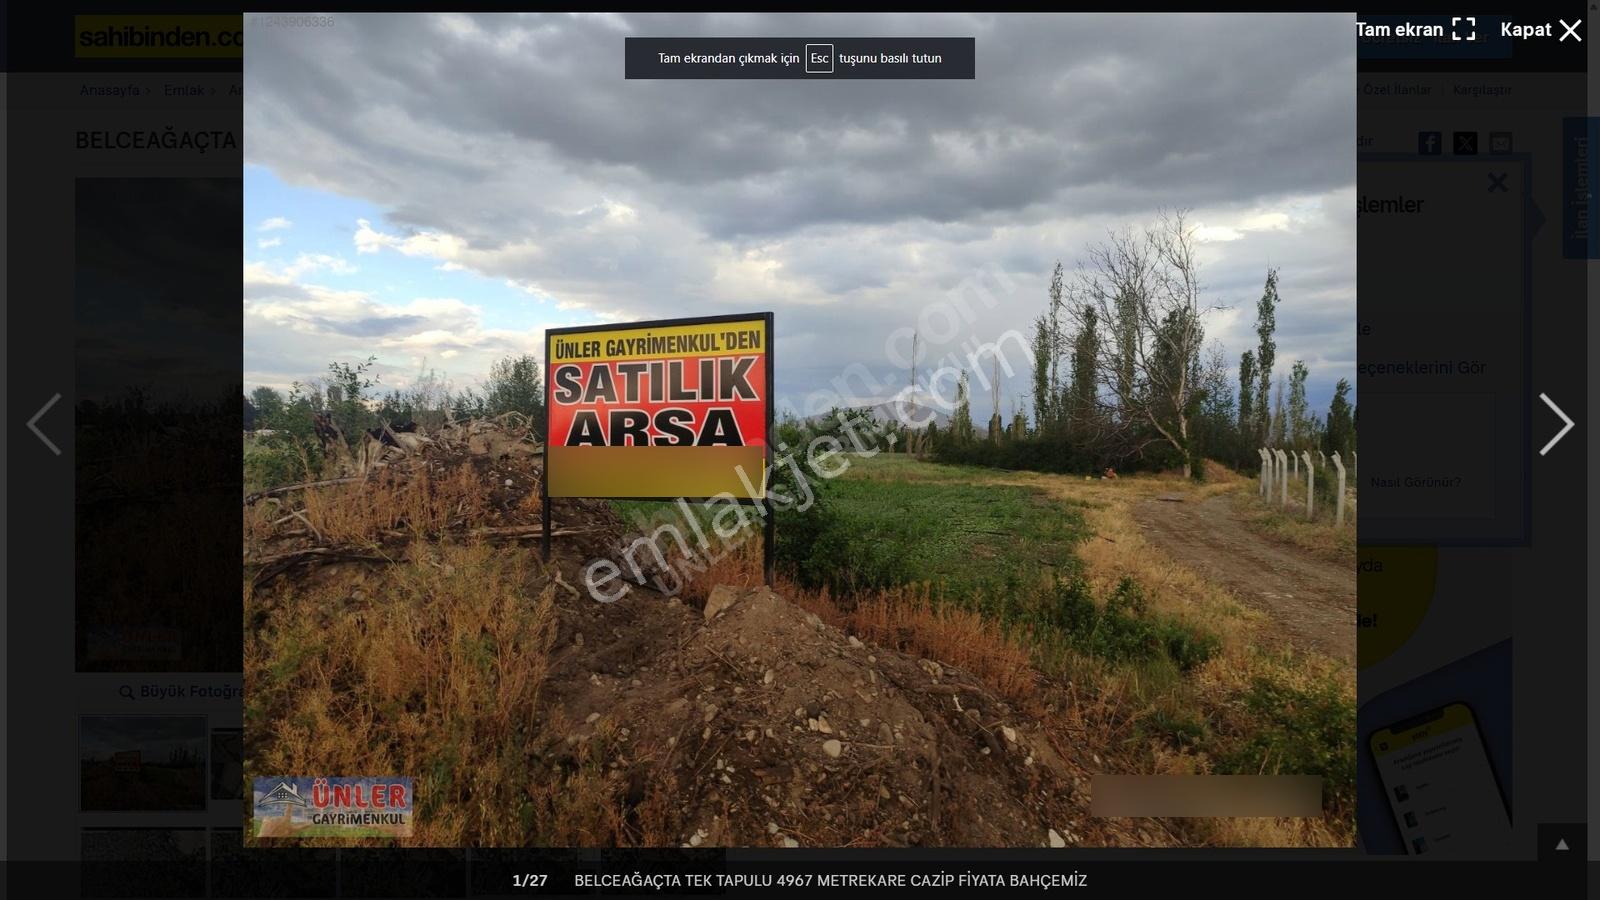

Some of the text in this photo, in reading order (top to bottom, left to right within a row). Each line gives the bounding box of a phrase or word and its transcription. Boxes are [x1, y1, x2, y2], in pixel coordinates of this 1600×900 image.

[1356, 22, 1444, 37] Tam ekran
[1501, 22, 1553, 40] Kapat
[658, 53, 942, 67] Tam ekrandan çıkmak için Esc tuşunu basılı tutun
[80, 84, 140, 98] Anasayfa
[164, 84, 205, 96] Emlak
[1363, 82, 1392, 96] Özel
[1453, 84, 1513, 98] Karşılaştır
[76, 126, 237, 153] BELCEAĞAÇTA
[555, 330, 761, 360] ÜNLER GAYRİMENKUL'DEN
[1458, 359, 1487, 374] Gör
[553, 355, 761, 406] SATILIK
[564, 407, 746, 446] ARSA
[1371, 476, 1462, 488] Nasıl Görünür?
[141, 684, 185, 699] Büyük
[512, 875, 548, 888] 1/27
[575, 870, 1087, 891] BELCEAĞAÇTA TEK TAPULU 4967 METREKARE CAZİP FİYATA BAHÇEMİZ
